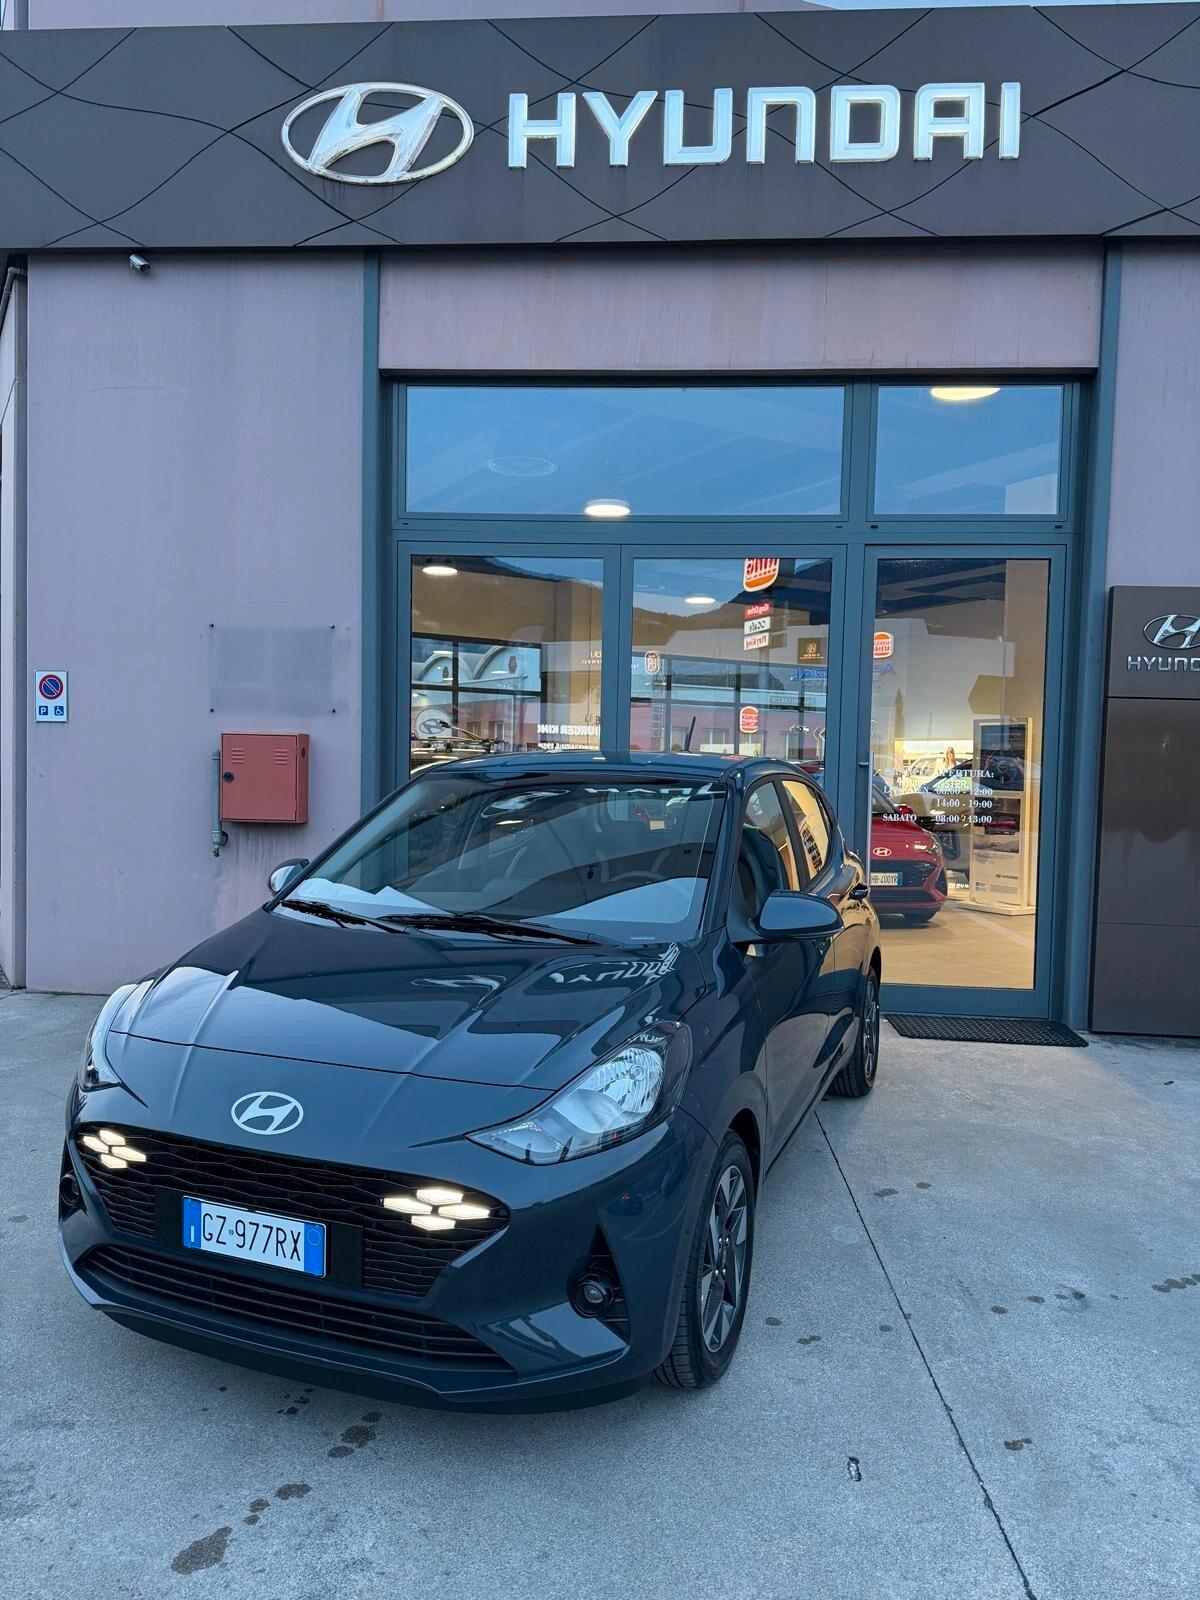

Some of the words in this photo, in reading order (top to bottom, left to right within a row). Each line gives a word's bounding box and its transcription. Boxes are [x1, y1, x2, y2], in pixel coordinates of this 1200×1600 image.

[508, 81, 1022, 168] HYUNDAI
[970, 788, 993, 796] 12:00
[936, 799, 960, 807] 14:00
[969, 800, 993, 809] 19:00
[882, 813, 917, 822] SABATO
[935, 814, 960, 823] 08:00
[969, 815, 993, 824] 13:00
